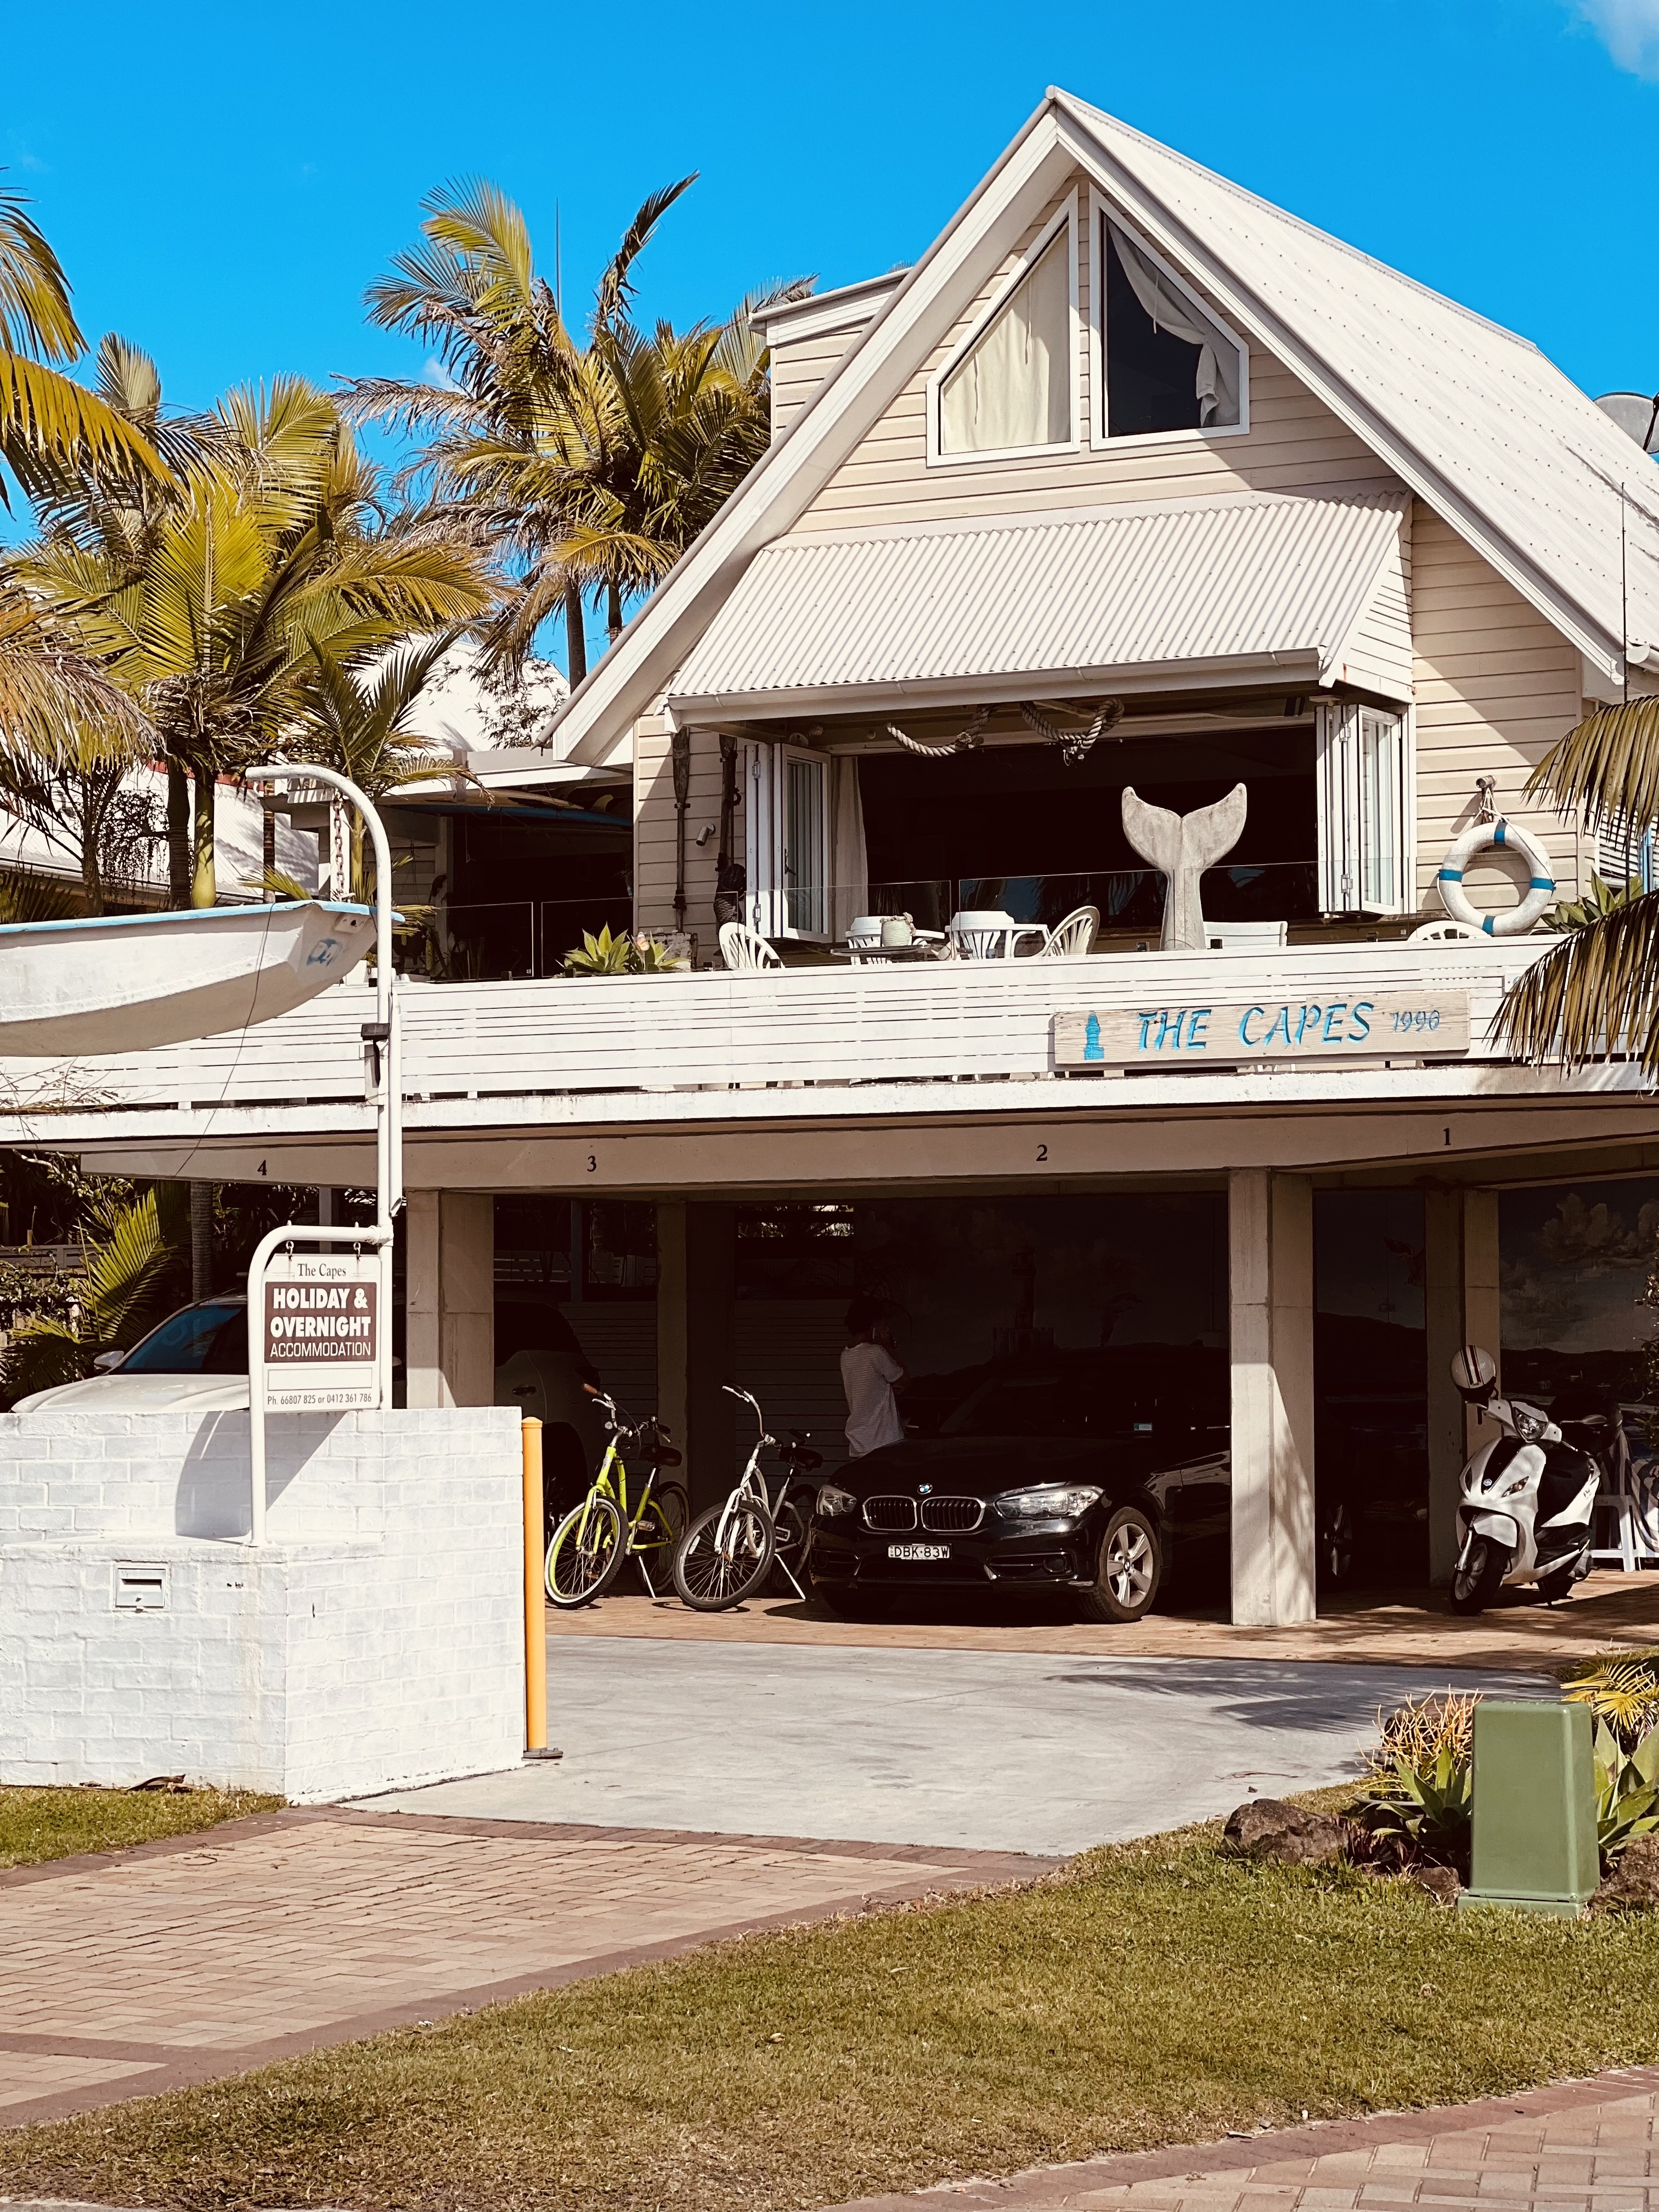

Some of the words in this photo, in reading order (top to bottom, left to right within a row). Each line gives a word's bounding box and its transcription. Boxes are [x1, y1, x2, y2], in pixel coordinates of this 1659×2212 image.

[1135, 1008, 1211, 1052] THE
[1238, 1002, 1375, 1048] CAPES
[1443, 1127, 1451, 1146] 1
[1036, 1144, 1048, 1161] 2
[257, 1159, 267, 1176] 4
[587, 1155, 597, 1172] 3
[297, 1263, 316, 1277] The
[319, 1263, 347, 1279] Capes
[273, 1288, 351, 1309] HOLIDAY
[354, 1288, 369, 1308] &
[270, 1316, 371, 1338] OVERNIGHT
[270, 1341, 371, 1357] ACCOMMODATION
[267, 1396, 278, 1405] Ph.
[280, 1395, 302, 1405] 66807
[303, 1395, 316, 1404] 825
[326, 1393, 343, 1403] 0412
[345, 1393, 357, 1403] 361
[359, 1393, 372, 1402] 786
